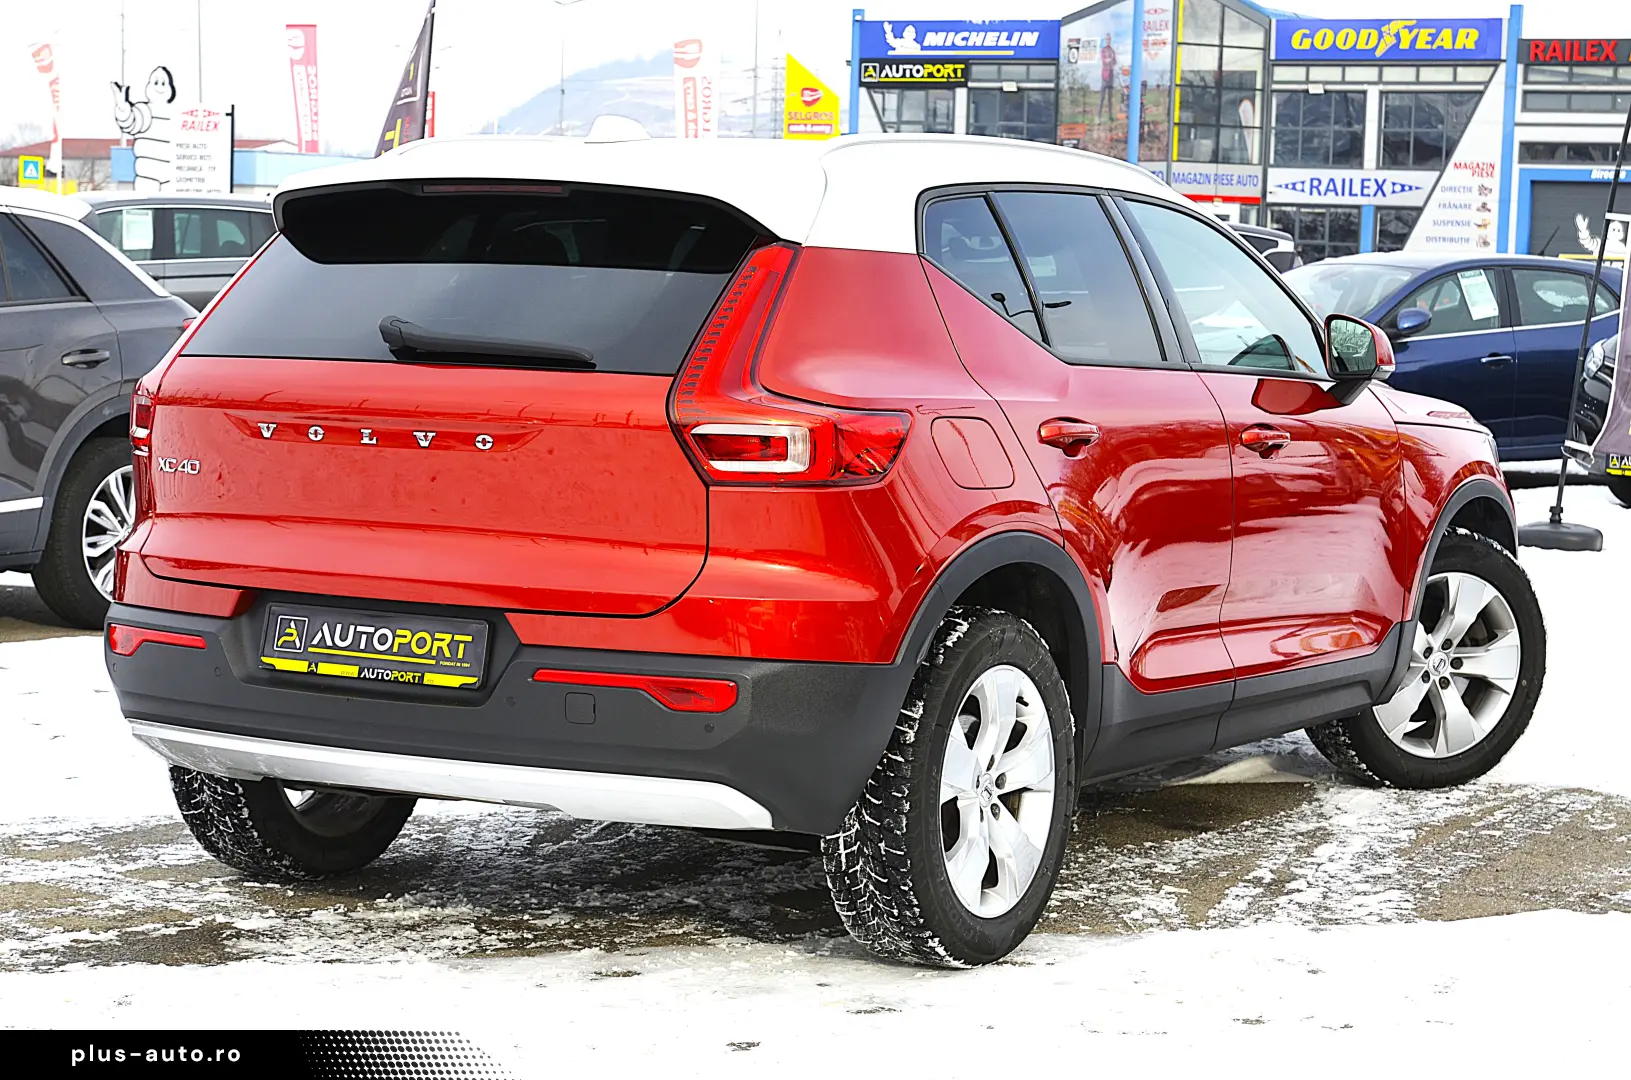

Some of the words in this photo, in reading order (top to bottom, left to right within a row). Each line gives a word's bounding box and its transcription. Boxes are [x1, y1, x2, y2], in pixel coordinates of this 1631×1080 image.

[922, 31, 1040, 47] MICHELIN
[1291, 28, 1479, 50] GOODYEAR
[1529, 40, 1618, 62] RAILEX
[880, 63, 965, 78] AUTOPORT
[788, 111, 834, 120] SELGROS
[181, 120, 220, 132] RAILEX
[1453, 162, 1495, 171] MAGAZIN
[1471, 169, 1495, 178] PIESE
[1172, 172, 1211, 185] MAGAZIN
[1213, 173, 1234, 186] PIESE
[1236, 175, 1259, 187] AUTO
[1309, 177, 1387, 198] RAILEX
[257, 422, 495, 450] VOLVO
[157, 457, 201, 474] XC40
[311, 622, 473, 659] AUTOPORT
[360, 668, 422, 683] AUTOPORT
